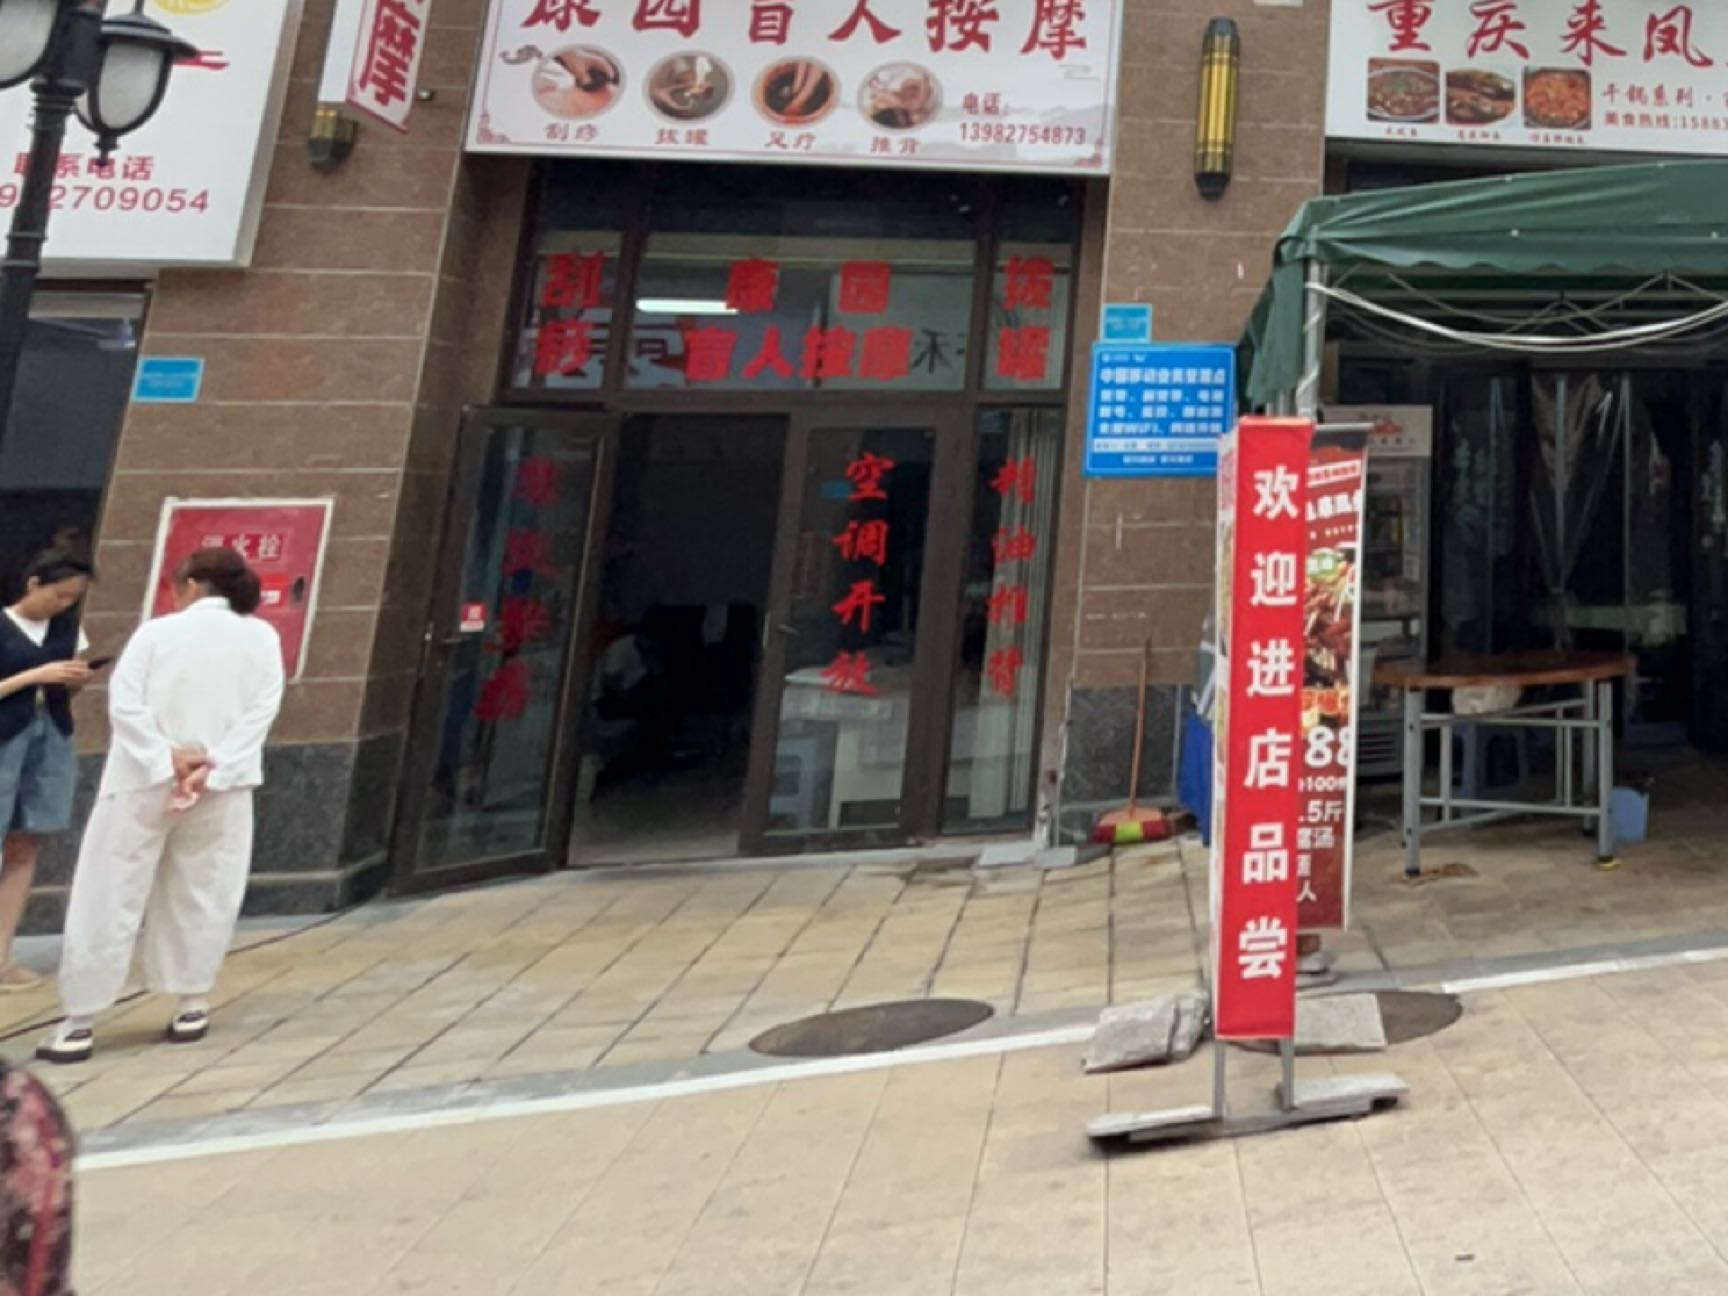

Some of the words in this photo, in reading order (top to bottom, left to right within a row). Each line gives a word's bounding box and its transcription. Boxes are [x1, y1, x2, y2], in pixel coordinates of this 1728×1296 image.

[0, 183, 209, 213] 92709054
[823, 452, 896, 695] 空调开放
[1238, 464, 1299, 980] 欢迎进店品尝
